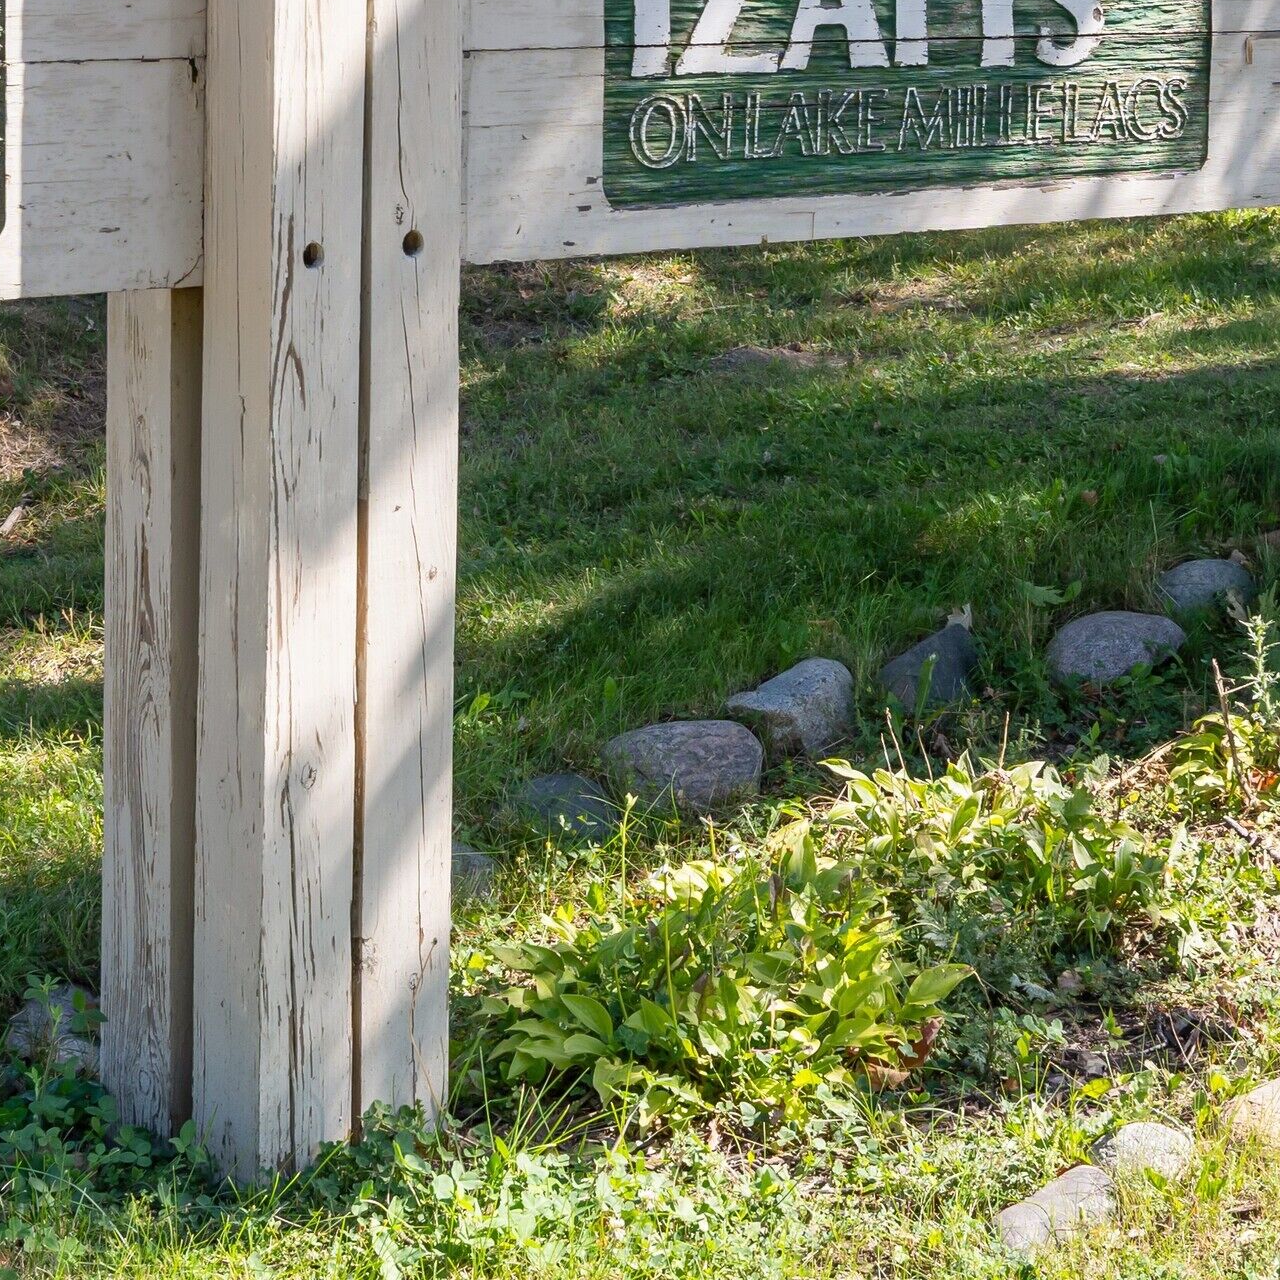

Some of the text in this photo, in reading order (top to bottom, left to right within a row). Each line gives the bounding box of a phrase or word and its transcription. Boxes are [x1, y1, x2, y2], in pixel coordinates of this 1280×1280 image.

[630, 76, 1191, 169] ON LAKE MILLE LACS
